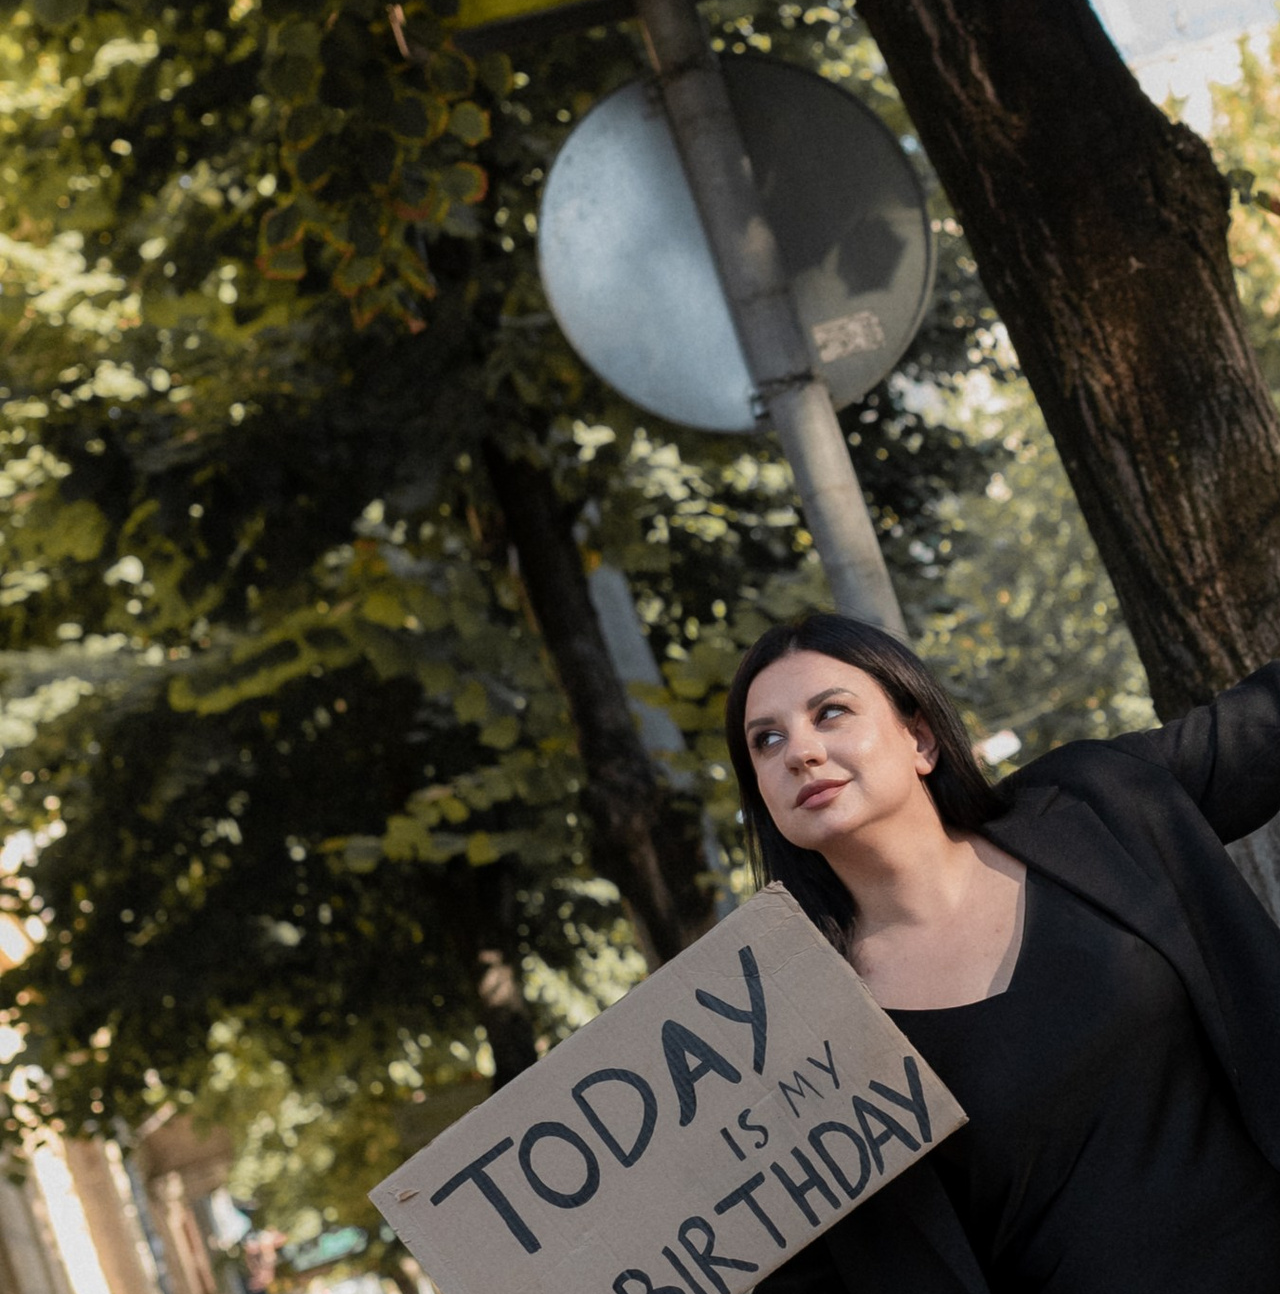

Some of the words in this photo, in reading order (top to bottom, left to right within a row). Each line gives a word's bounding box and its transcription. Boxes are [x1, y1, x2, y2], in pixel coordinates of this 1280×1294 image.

[430, 944, 769, 1255] TODAY
[719, 1108, 770, 1162] IS
[777, 1039, 842, 1119] MY
